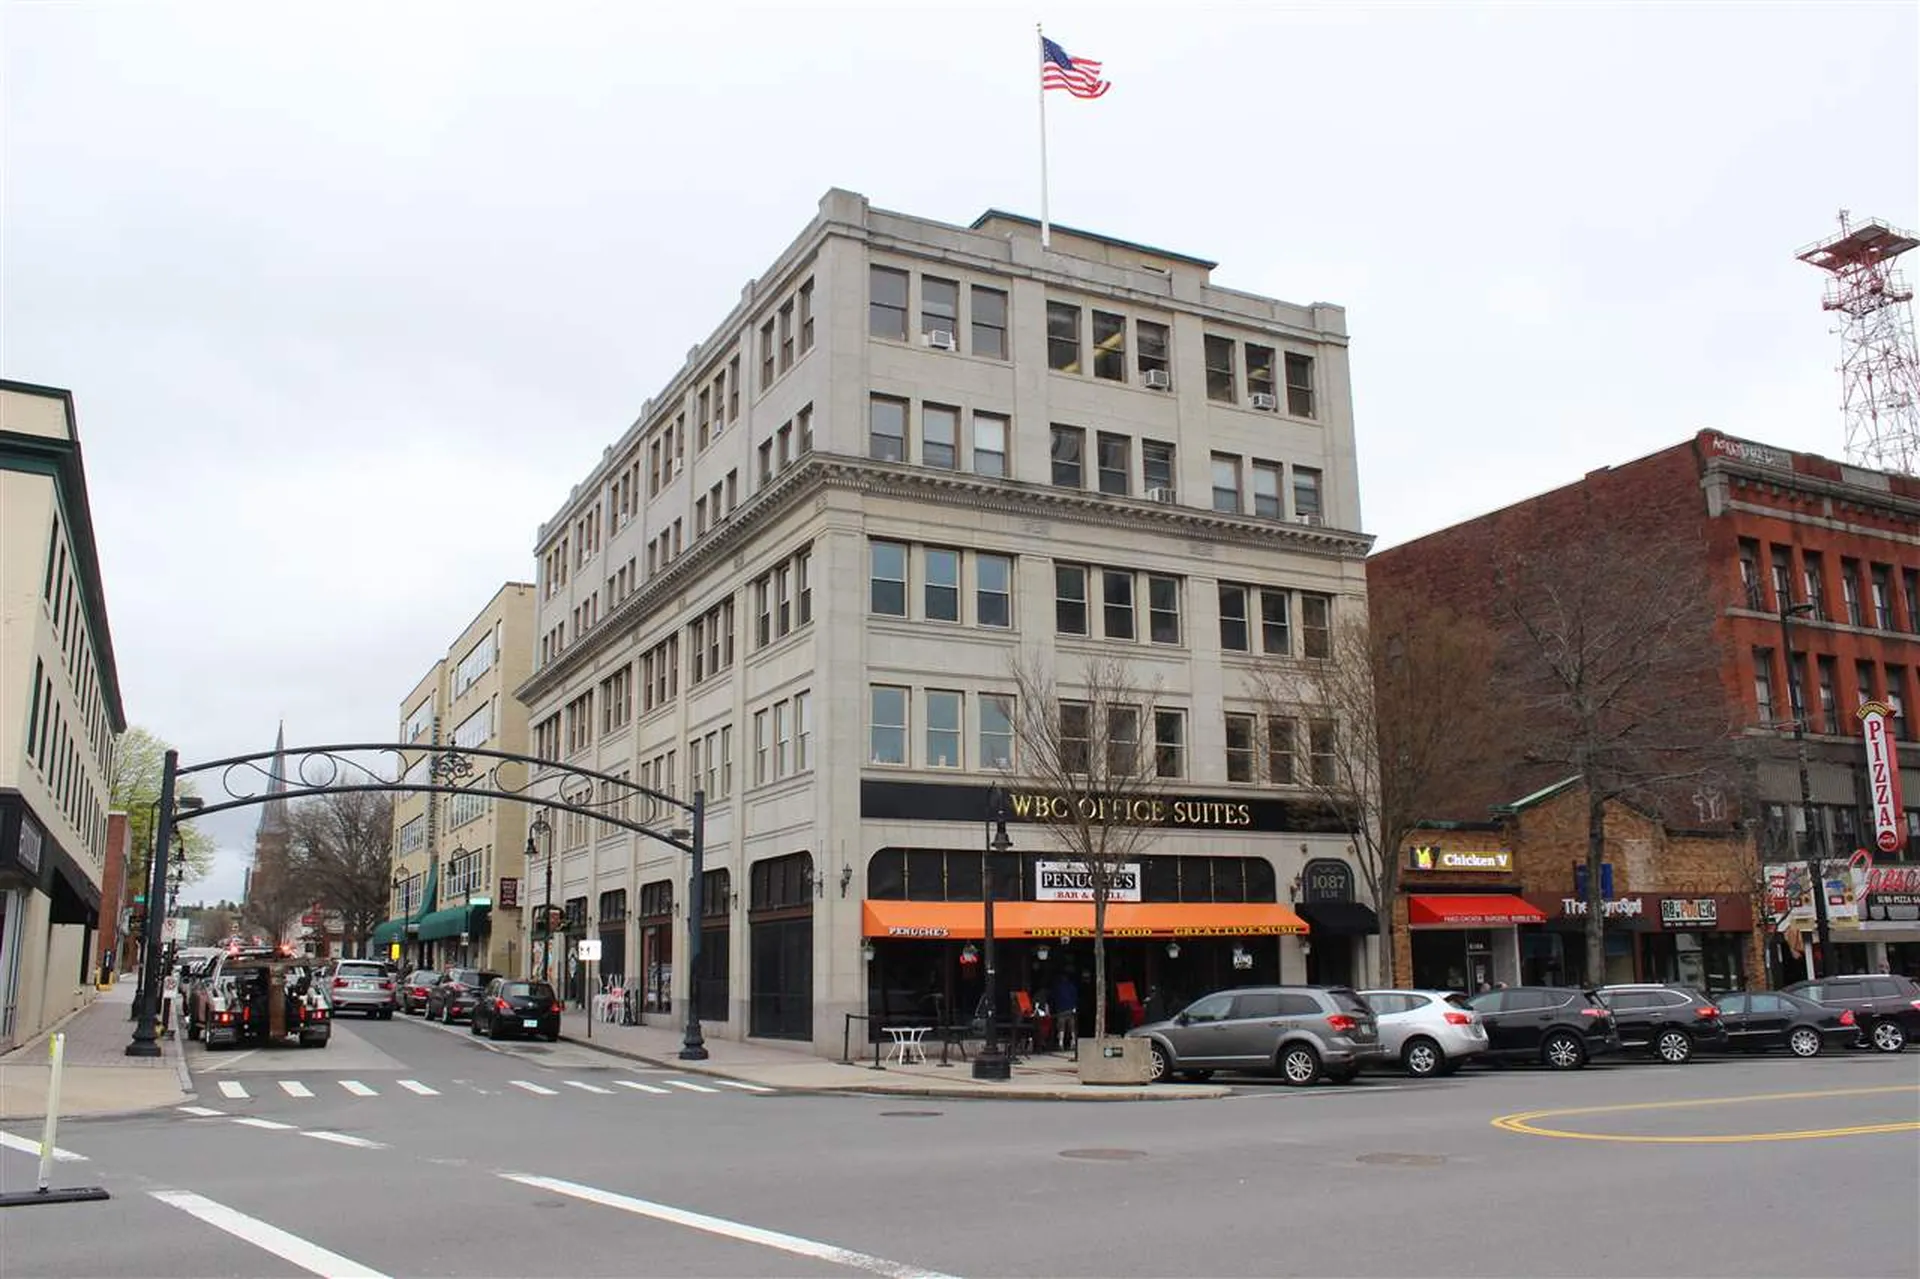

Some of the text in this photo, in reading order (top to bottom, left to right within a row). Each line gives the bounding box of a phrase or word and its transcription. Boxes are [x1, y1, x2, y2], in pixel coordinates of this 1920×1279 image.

[1868, 720, 1893, 827] PIZZA
[1009, 795, 1068, 818] WBC
[1174, 801, 1251, 825] SUITES
[1443, 853, 1508, 867] Chicken V
[1312, 875, 1346, 889] 1087
[1561, 898, 1587, 915] The
[888, 926, 949, 937] PENUCHE'S
[1031, 927, 1090, 937] DRINKS
[1112, 927, 1153, 937] FOOD
[1173, 925, 1299, 936] GREAT LIVE MUSIC
